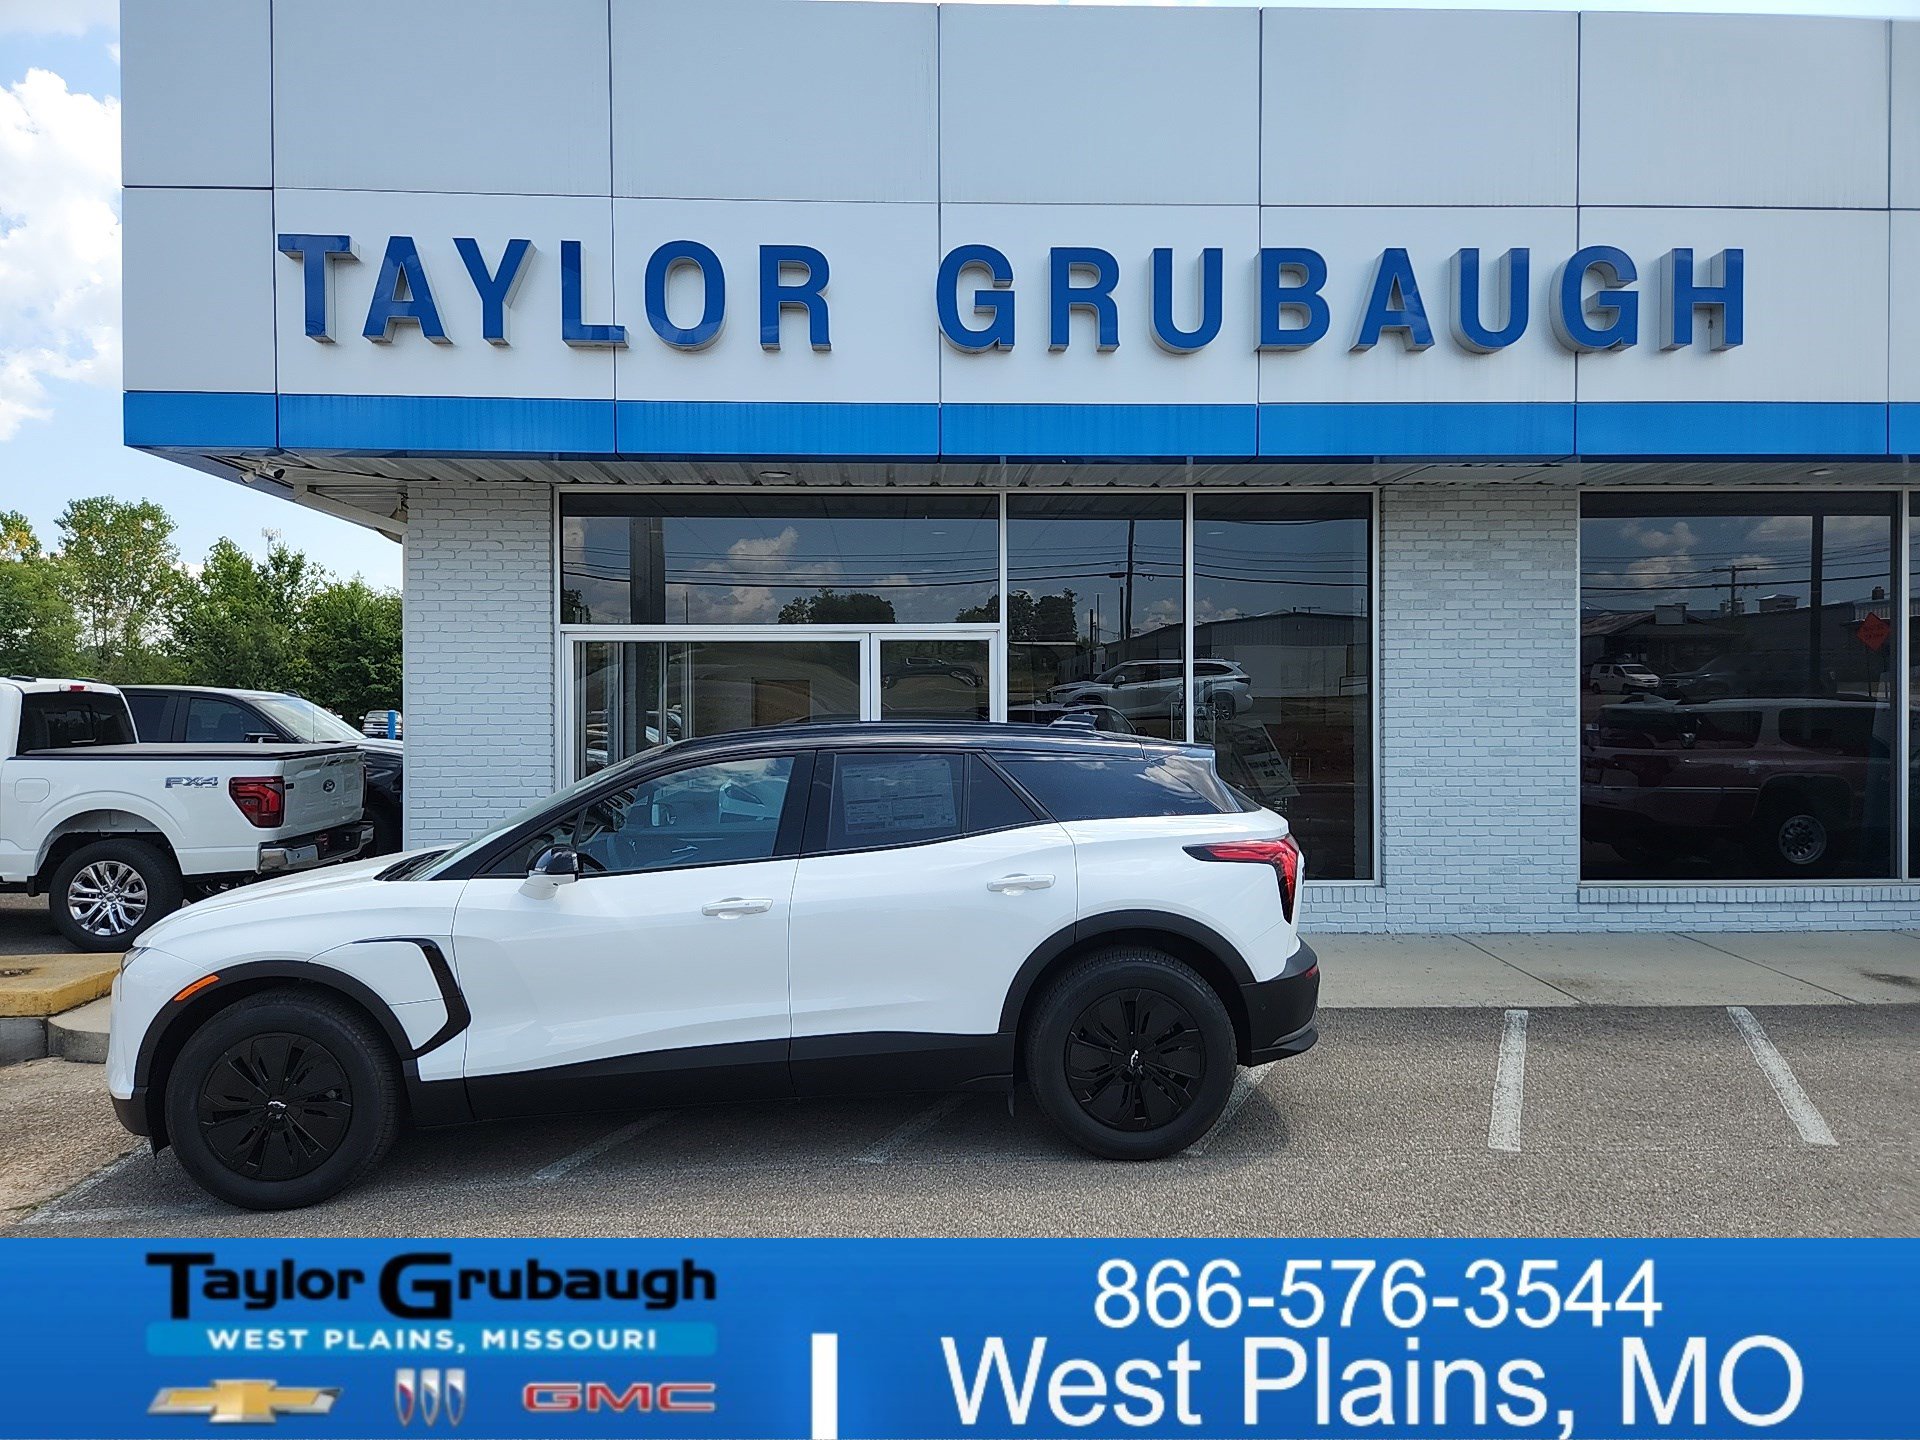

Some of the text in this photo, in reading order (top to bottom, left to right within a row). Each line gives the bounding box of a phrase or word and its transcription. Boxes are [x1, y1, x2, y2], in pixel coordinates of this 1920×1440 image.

[277, 233, 1745, 354] TAYLOR GRUBAUGH
[165, 776, 219, 788] FX4
